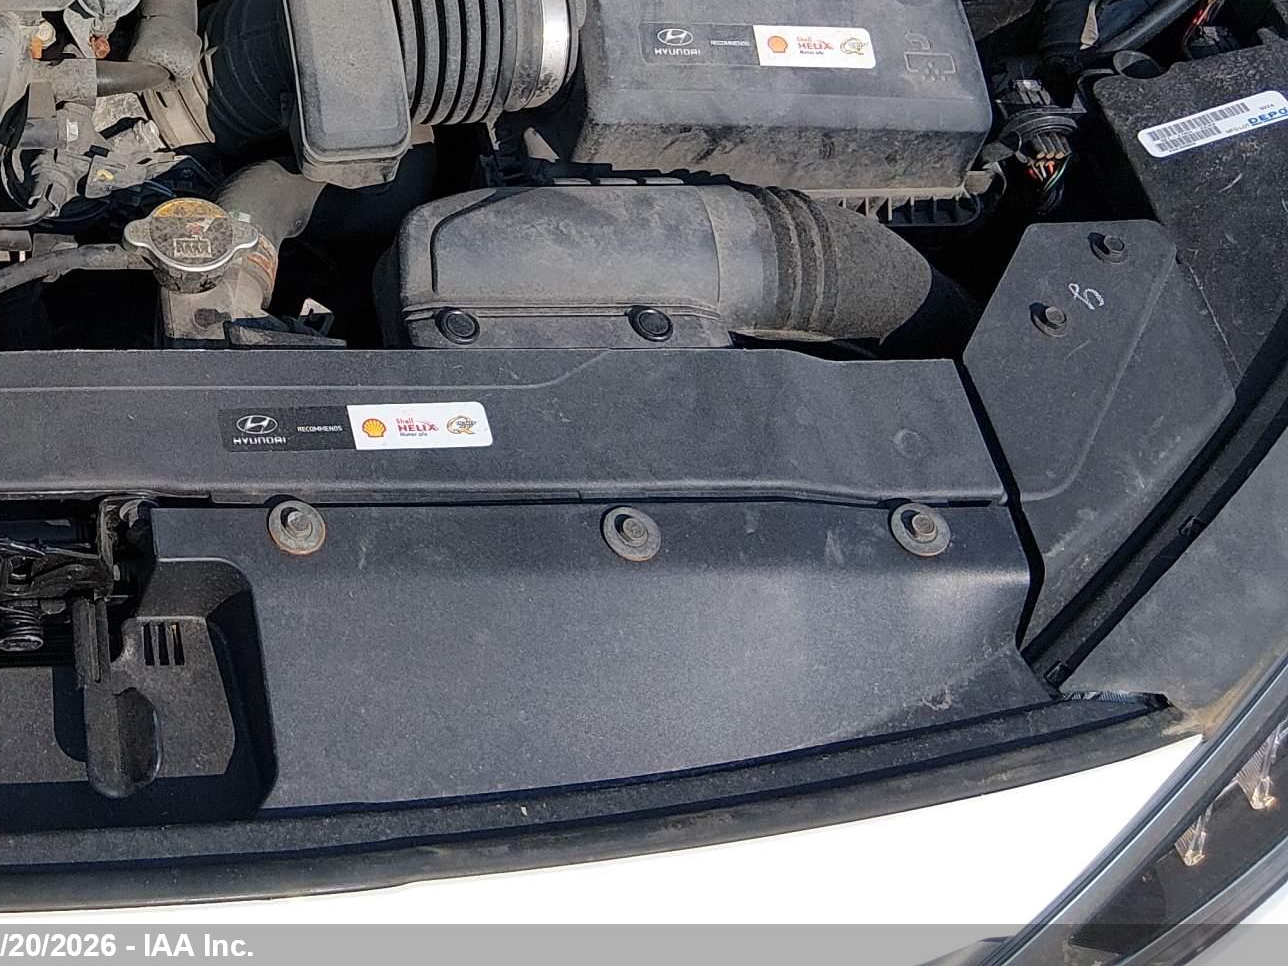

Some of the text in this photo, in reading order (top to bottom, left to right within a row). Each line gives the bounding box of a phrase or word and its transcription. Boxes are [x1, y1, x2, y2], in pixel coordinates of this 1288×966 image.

[798, 42, 832, 50] HELIX
[654, 47, 701, 56] HYUNDAI
[1248, 108, 1288, 124] DEPO
[397, 424, 437, 432] HELIX
[233, 436, 287, 445] HYUNDAI
